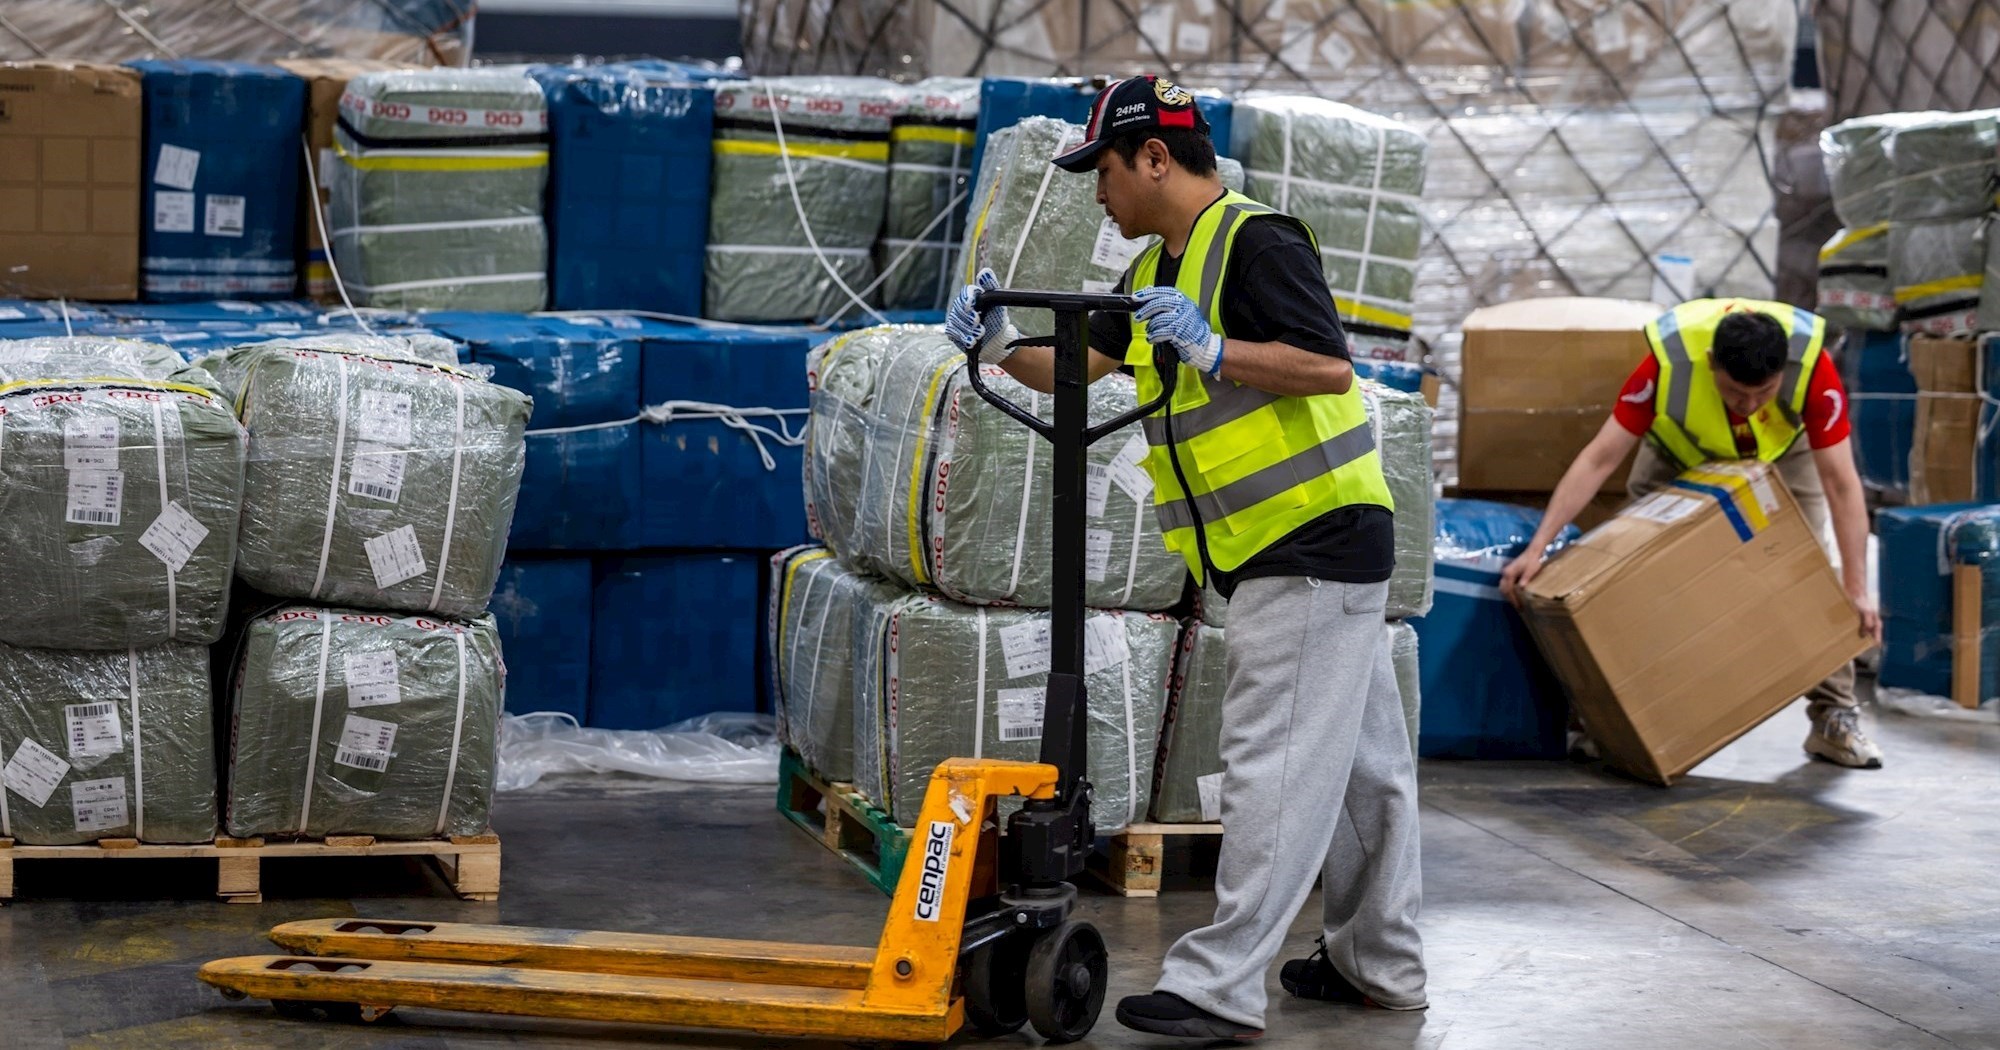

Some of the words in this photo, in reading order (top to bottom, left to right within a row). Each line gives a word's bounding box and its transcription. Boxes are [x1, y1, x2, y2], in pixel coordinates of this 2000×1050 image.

[372, 102, 411, 121] CDG
[428, 107, 468, 126] CDG
[1115, 102, 1146, 117] 24HR
[484, 111, 523, 128] CDG
[32, 392, 83, 408] CDG
[108, 391, 160, 402] CDG
[935, 461, 950, 513] CDG
[341, 614, 393, 627] CDG
[917, 823, 946, 919] cenpac
